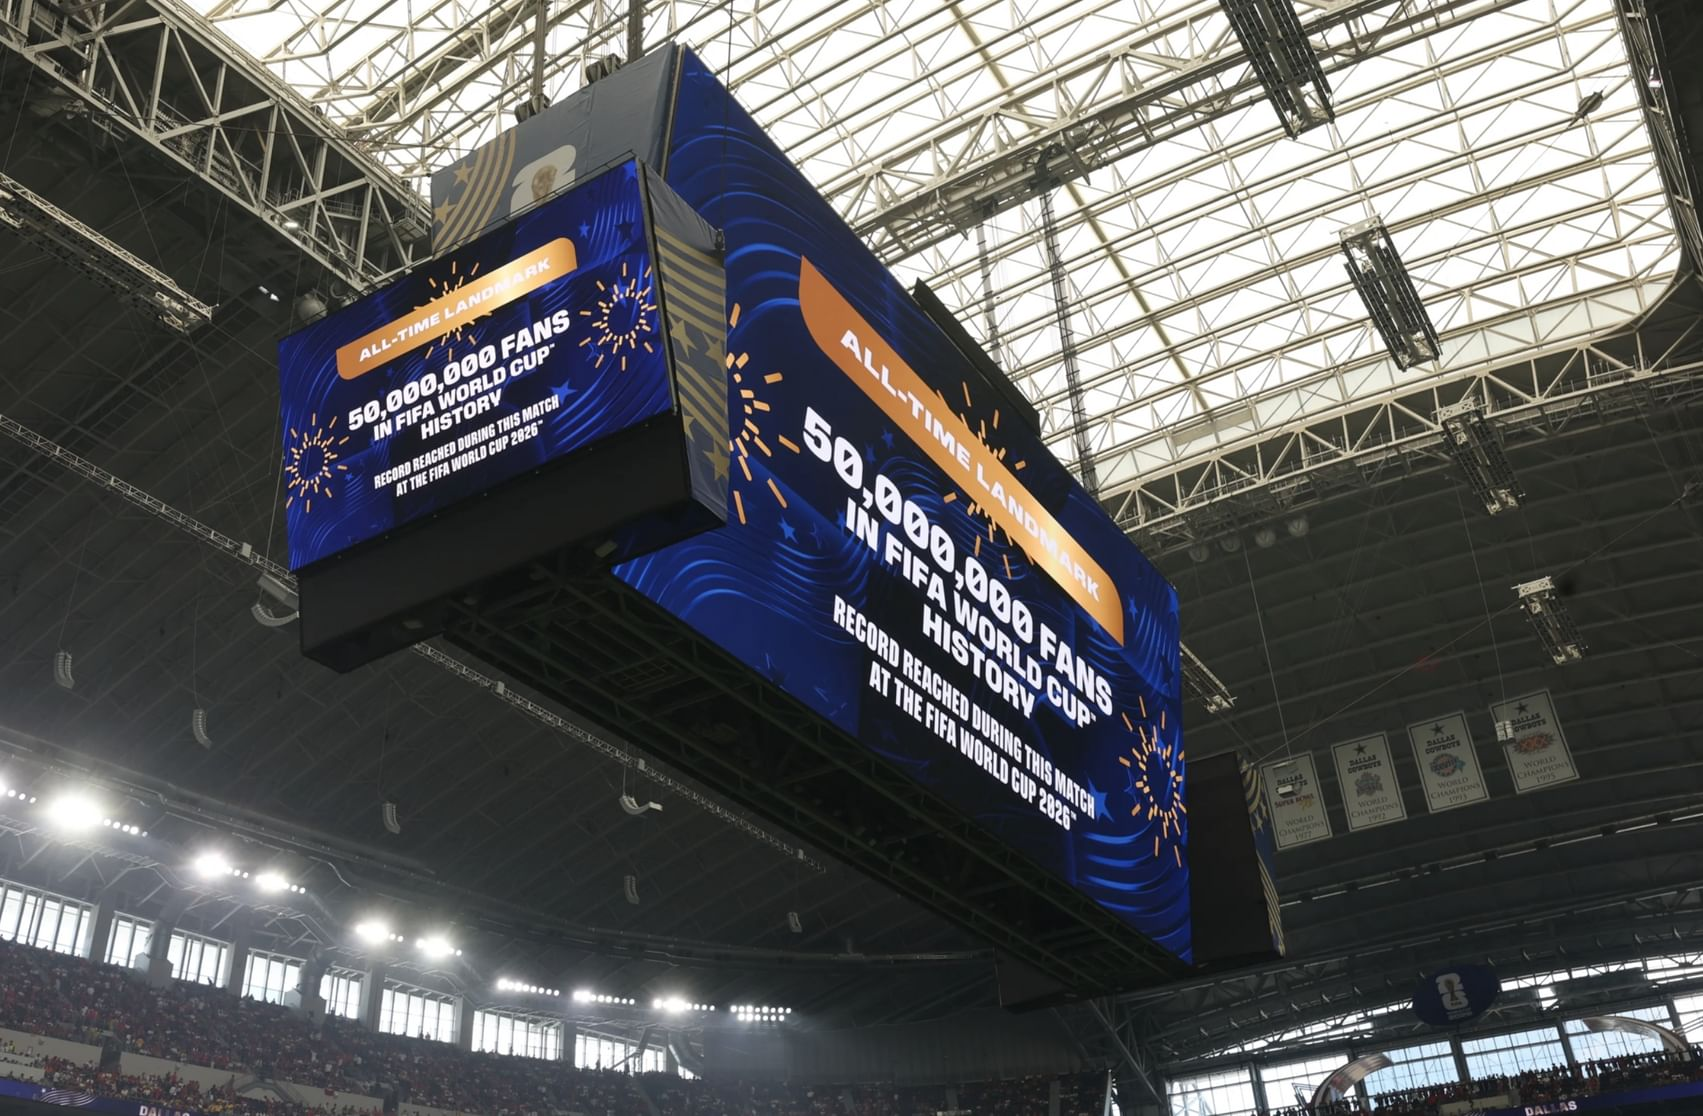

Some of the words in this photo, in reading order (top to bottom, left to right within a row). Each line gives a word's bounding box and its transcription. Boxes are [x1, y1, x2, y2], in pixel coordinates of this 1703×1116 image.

[359, 312, 441, 362] ALL-TIME
[444, 257, 551, 320] LANDMARK
[349, 345, 496, 431] 50,000,000
[501, 310, 570, 360] FANS
[374, 419, 392, 441] IN
[396, 400, 435, 432] FIFA
[438, 366, 507, 411] WORLD
[421, 388, 502, 440] HISTORY
[374, 461, 412, 489] RECORD
[412, 442, 456, 472] REACHED
[458, 424, 495, 452] DURING
[496, 412, 521, 434] THIS
[522, 394, 560, 423] MATCH
[396, 480, 408, 497] AT
[409, 471, 428, 491] THE
[429, 462, 450, 483] FIFA
[451, 445, 487, 473] WORLD
[489, 435, 508, 456] CUP
[841, 330, 971, 471] ALL-TIME
[977, 463, 1100, 602] LANDMARK
[803, 406, 1034, 643] 50,000,000
[1040, 622, 1113, 716] FANS
[846, 498, 878, 552] IN
[885, 531, 947, 611] FIFA
[953, 590, 1042, 690] WORLD
[922, 603, 1035, 719] HISTORY
[833, 594, 900, 668] RECORD
[902, 648, 970, 722] REACHED
[972, 703, 1022, 764] DURING
[1025, 744, 1053, 786] THIS
[1055, 768, 1095, 820] MATCH
[1510, 713, 1541, 725] DALLAS
[1513, 720, 1547, 733] OWBOYS
[869, 660, 892, 698] AT
[894, 676, 923, 723] THE
[926, 701, 957, 748] FIFA
[960, 727, 1009, 784] WORLD
[1012, 767, 1036, 804] CUP
[1425, 741, 1461, 754] COWBOYS
[1426, 735, 1455, 746] DALLAS
[1347, 761, 1382, 774] COWBOYS
[1349, 755, 1376, 766] DALLAS
[1523, 756, 1556, 768] WORLD
[1277, 774, 1304, 785] DALLAS
[1517, 763, 1569, 780] CHAMPIONS
[1535, 774, 1556, 784] 1995
[1437, 777, 1469, 789] WORLD
[1431, 784, 1481, 800] CHAMPIONS
[1274, 800, 1294, 809] SUPER
[1351, 803, 1399, 818] CHAMPIONS
[1358, 798, 1388, 808] WORLD
[1278, 821, 1325, 838] CHAMPIONS
[1286, 816, 1314, 828] WORLD
[1525, 1100, 1578, 1116] DALLAS
